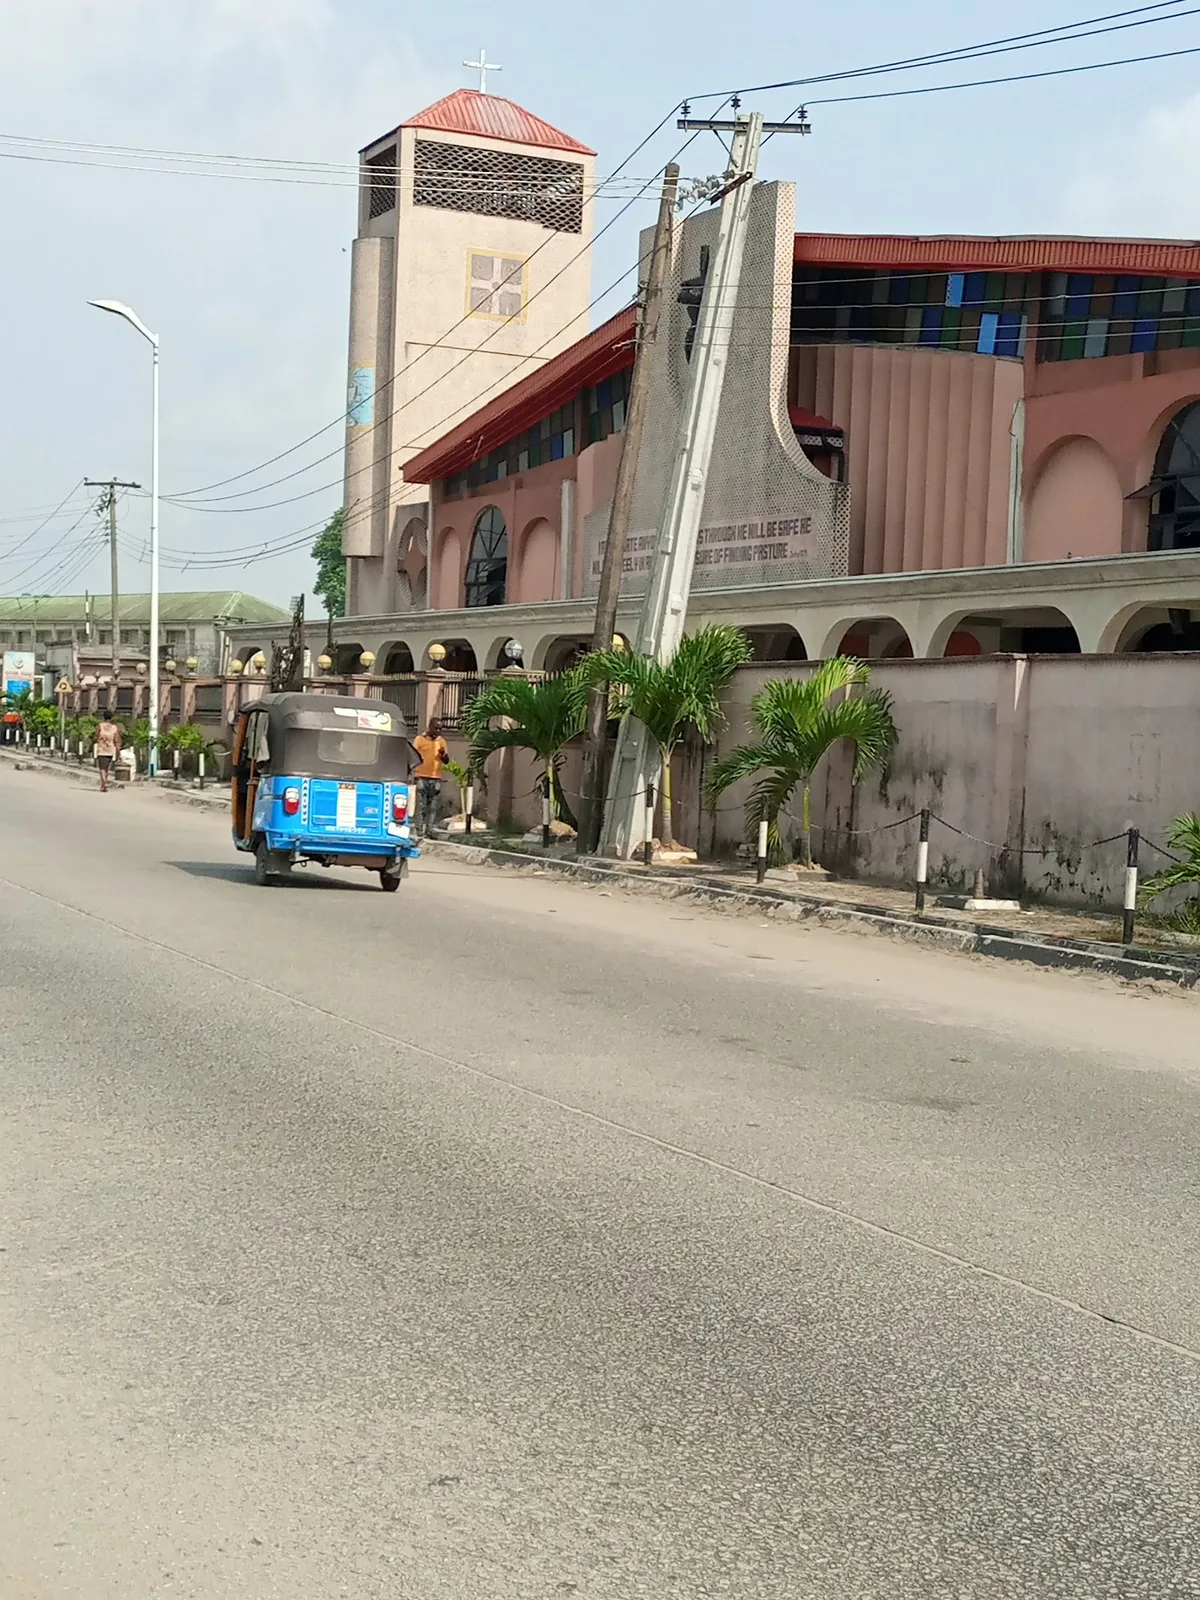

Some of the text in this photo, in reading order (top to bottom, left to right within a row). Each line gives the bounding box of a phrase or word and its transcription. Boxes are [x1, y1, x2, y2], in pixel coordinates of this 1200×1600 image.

[766, 521, 778, 538] BE
[778, 518, 799, 536] SAFE
[800, 516, 812, 535] HE
[713, 548, 723, 564] OF
[753, 542, 788, 561] PASTURE
